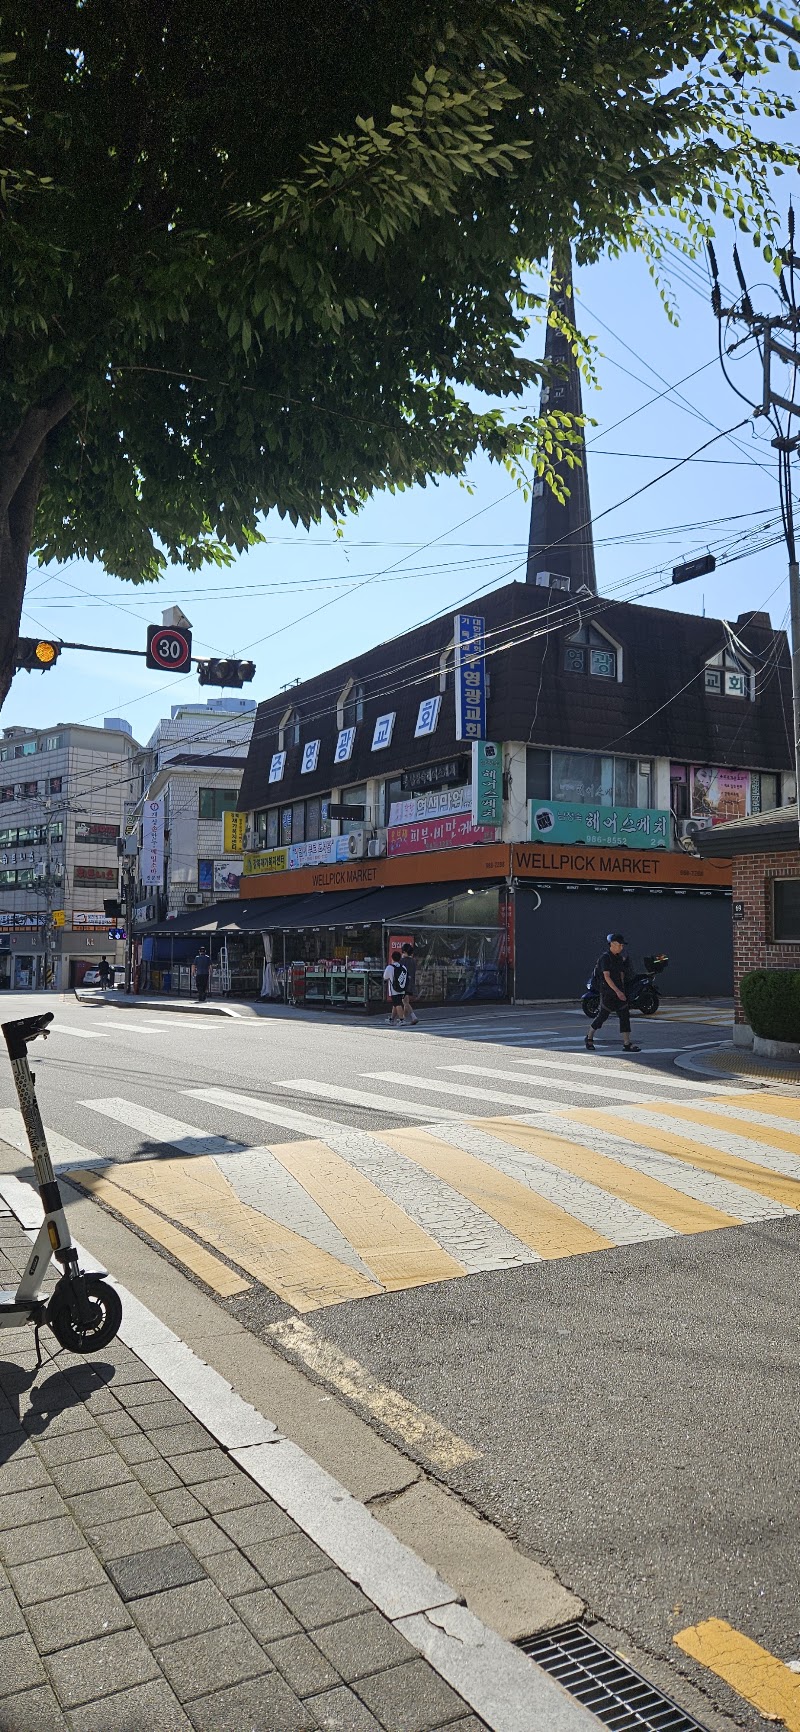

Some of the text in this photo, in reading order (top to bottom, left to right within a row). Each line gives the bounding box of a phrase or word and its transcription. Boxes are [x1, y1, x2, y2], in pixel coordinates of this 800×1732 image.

[158, 639, 181, 659] 30
[567, 648, 613, 674] 영광
[704, 672, 744, 694] 교회
[464, 653, 482, 739] 주영광교회
[271, 700, 437, 781] 주영광교회
[416, 788, 465, 817] 염색만원
[557, 809, 668, 837] 남정숙 헤어스케치
[586, 835, 628, 846] 986-8552
[515, 852, 660, 875] WELLPICK MARKET
[312, 866, 377, 887] WELLPICK MARKET
